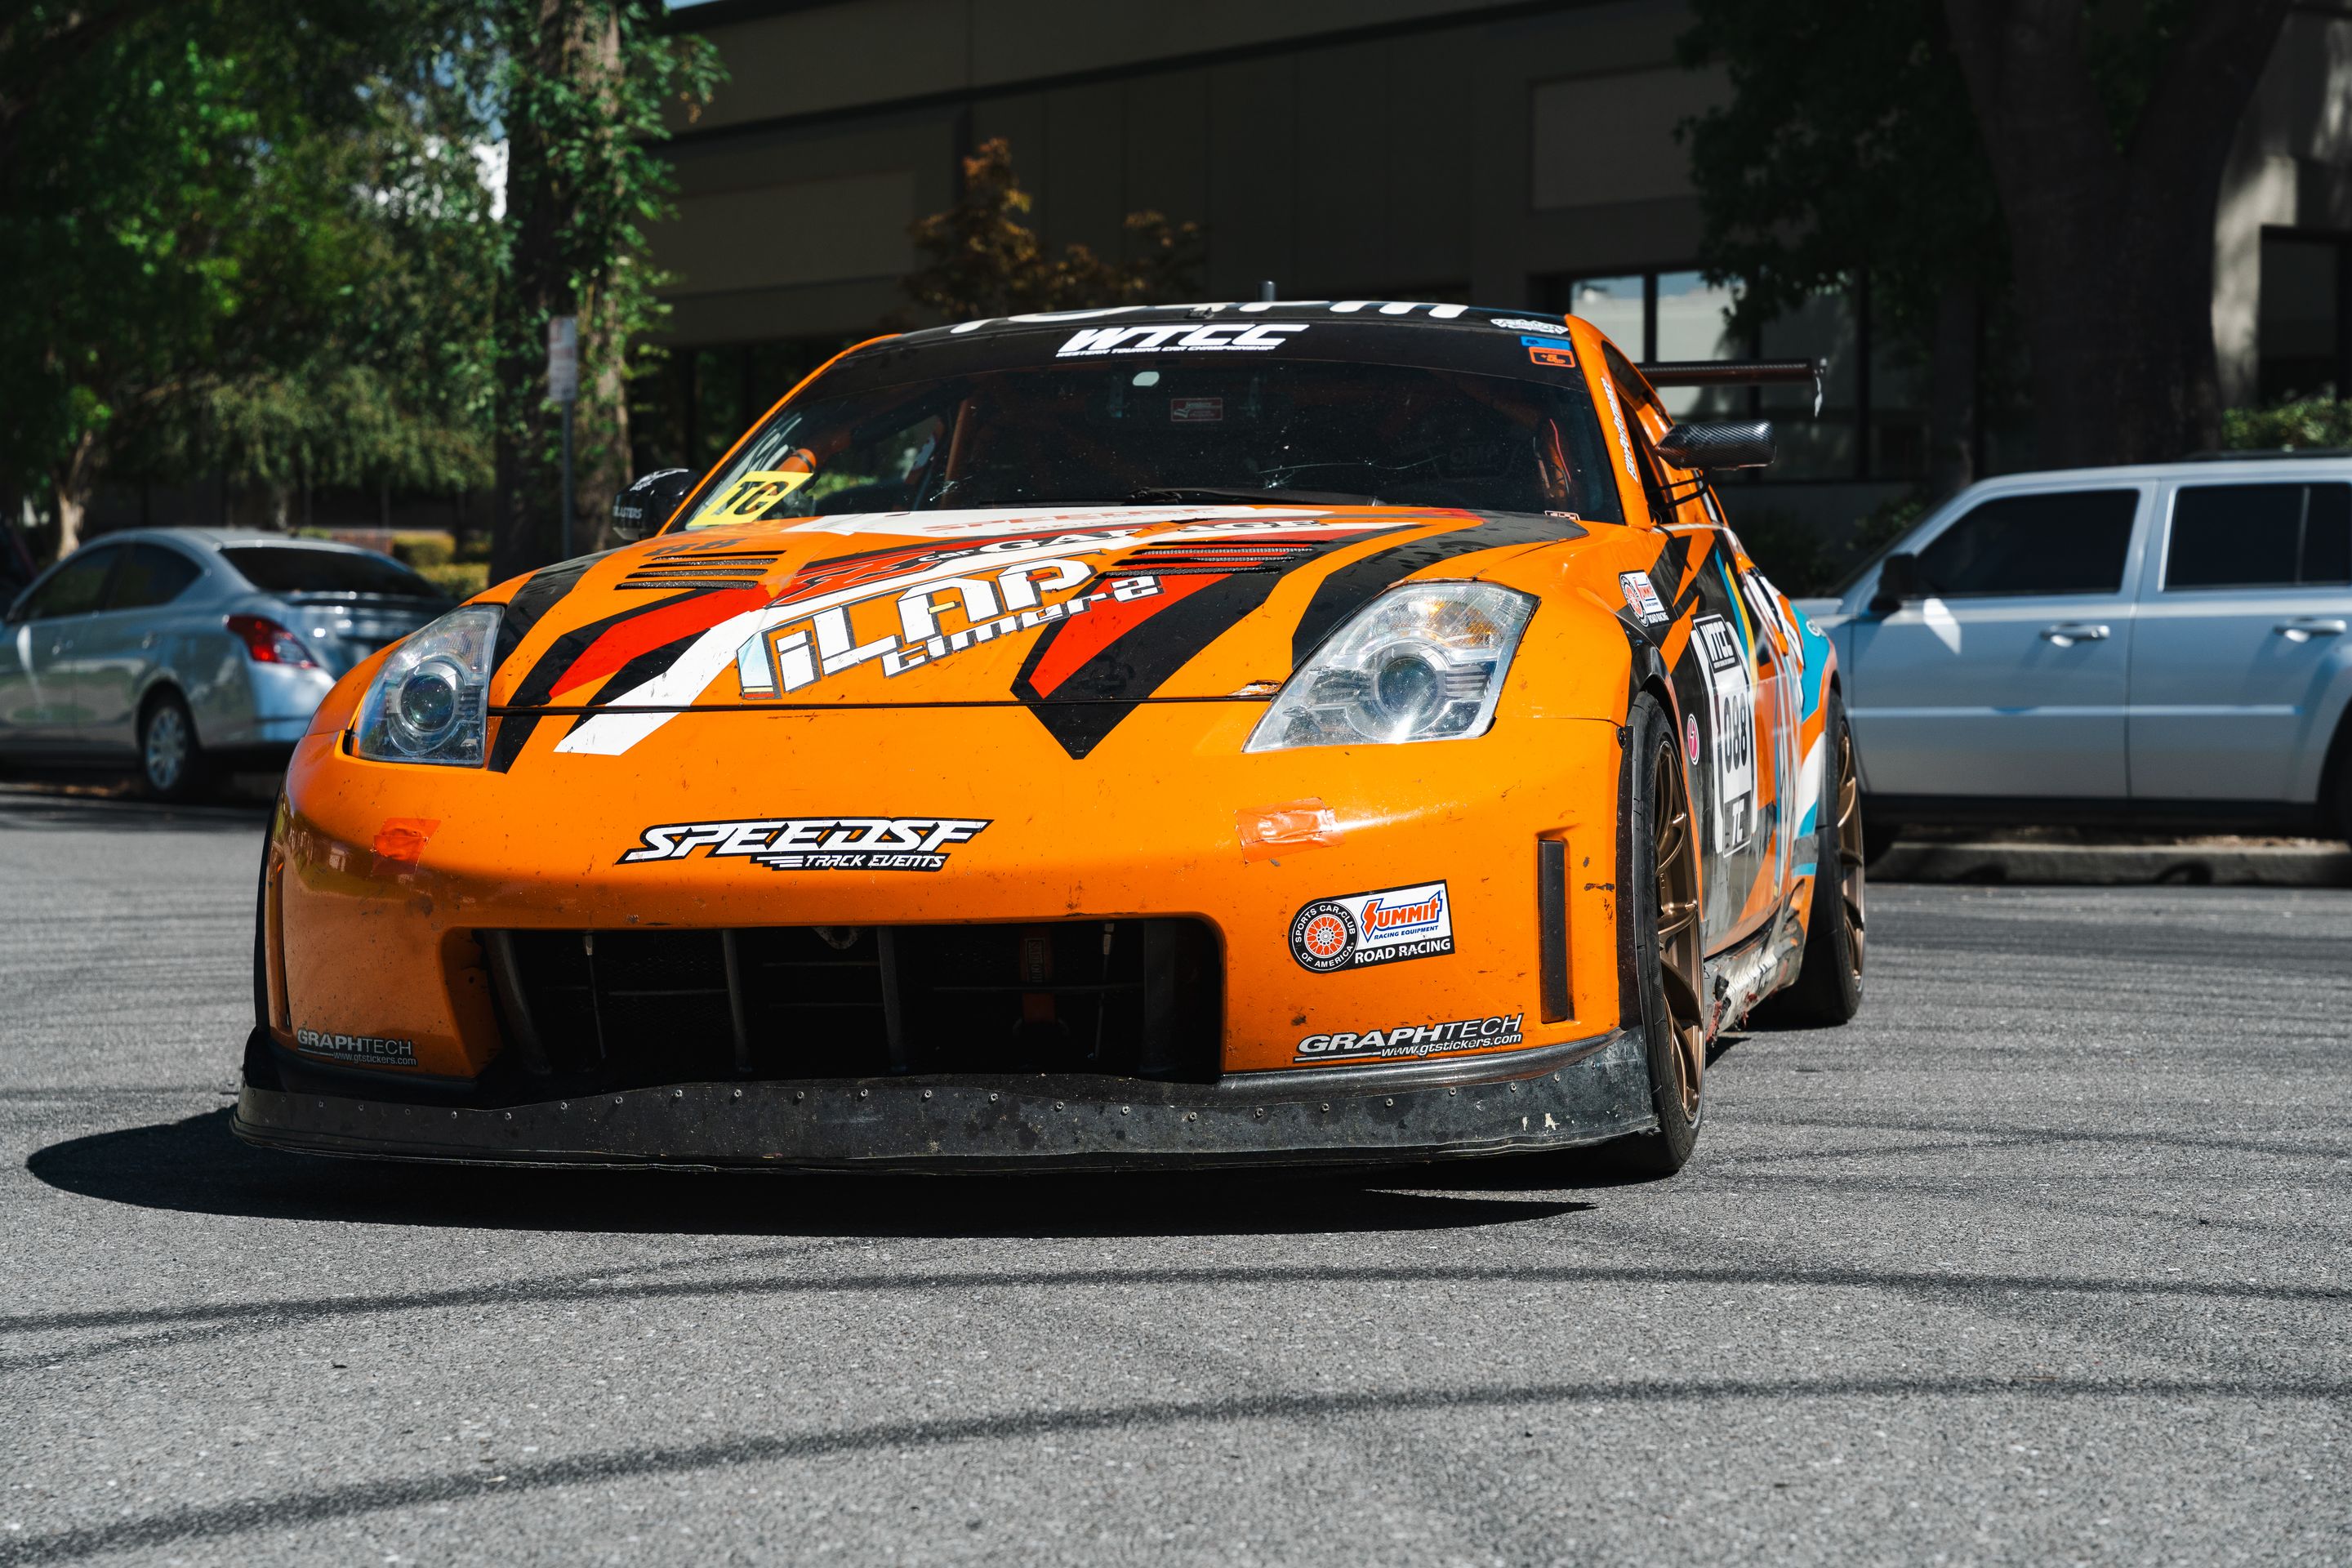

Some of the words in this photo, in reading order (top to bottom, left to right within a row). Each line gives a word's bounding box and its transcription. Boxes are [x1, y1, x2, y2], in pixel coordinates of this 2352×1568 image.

[1058, 324, 1309, 352] WTCC
[711, 481, 789, 514] TC
[1699, 621, 1734, 662] WTCC
[1724, 693, 1748, 773] 088
[1731, 798, 1745, 846] TC
[626, 819, 988, 861] SPEEDSF
[804, 855, 862, 867] TRACK
[867, 855, 947, 867] EVENTS
[1295, 908, 1317, 942] SPORTS
[1319, 905, 1339, 913] CAR
[1340, 911, 1356, 935] CLUB
[1374, 931, 1400, 940] RACING
[1401, 925, 1439, 937] EQUIPMENT
[1301, 952, 1312, 963] OF
[1315, 946, 1354, 968] AMERICA
[1354, 947, 1395, 964] ROAD
[1398, 938, 1450, 957] RACING
[298, 1030, 412, 1055] GRAPHTECH
[1298, 1014, 1523, 1053] GRAPHTECH
[1381, 1034, 1522, 1056] www.gtstickers.com
[333, 1051, 416, 1065] www.gtstickers.com
